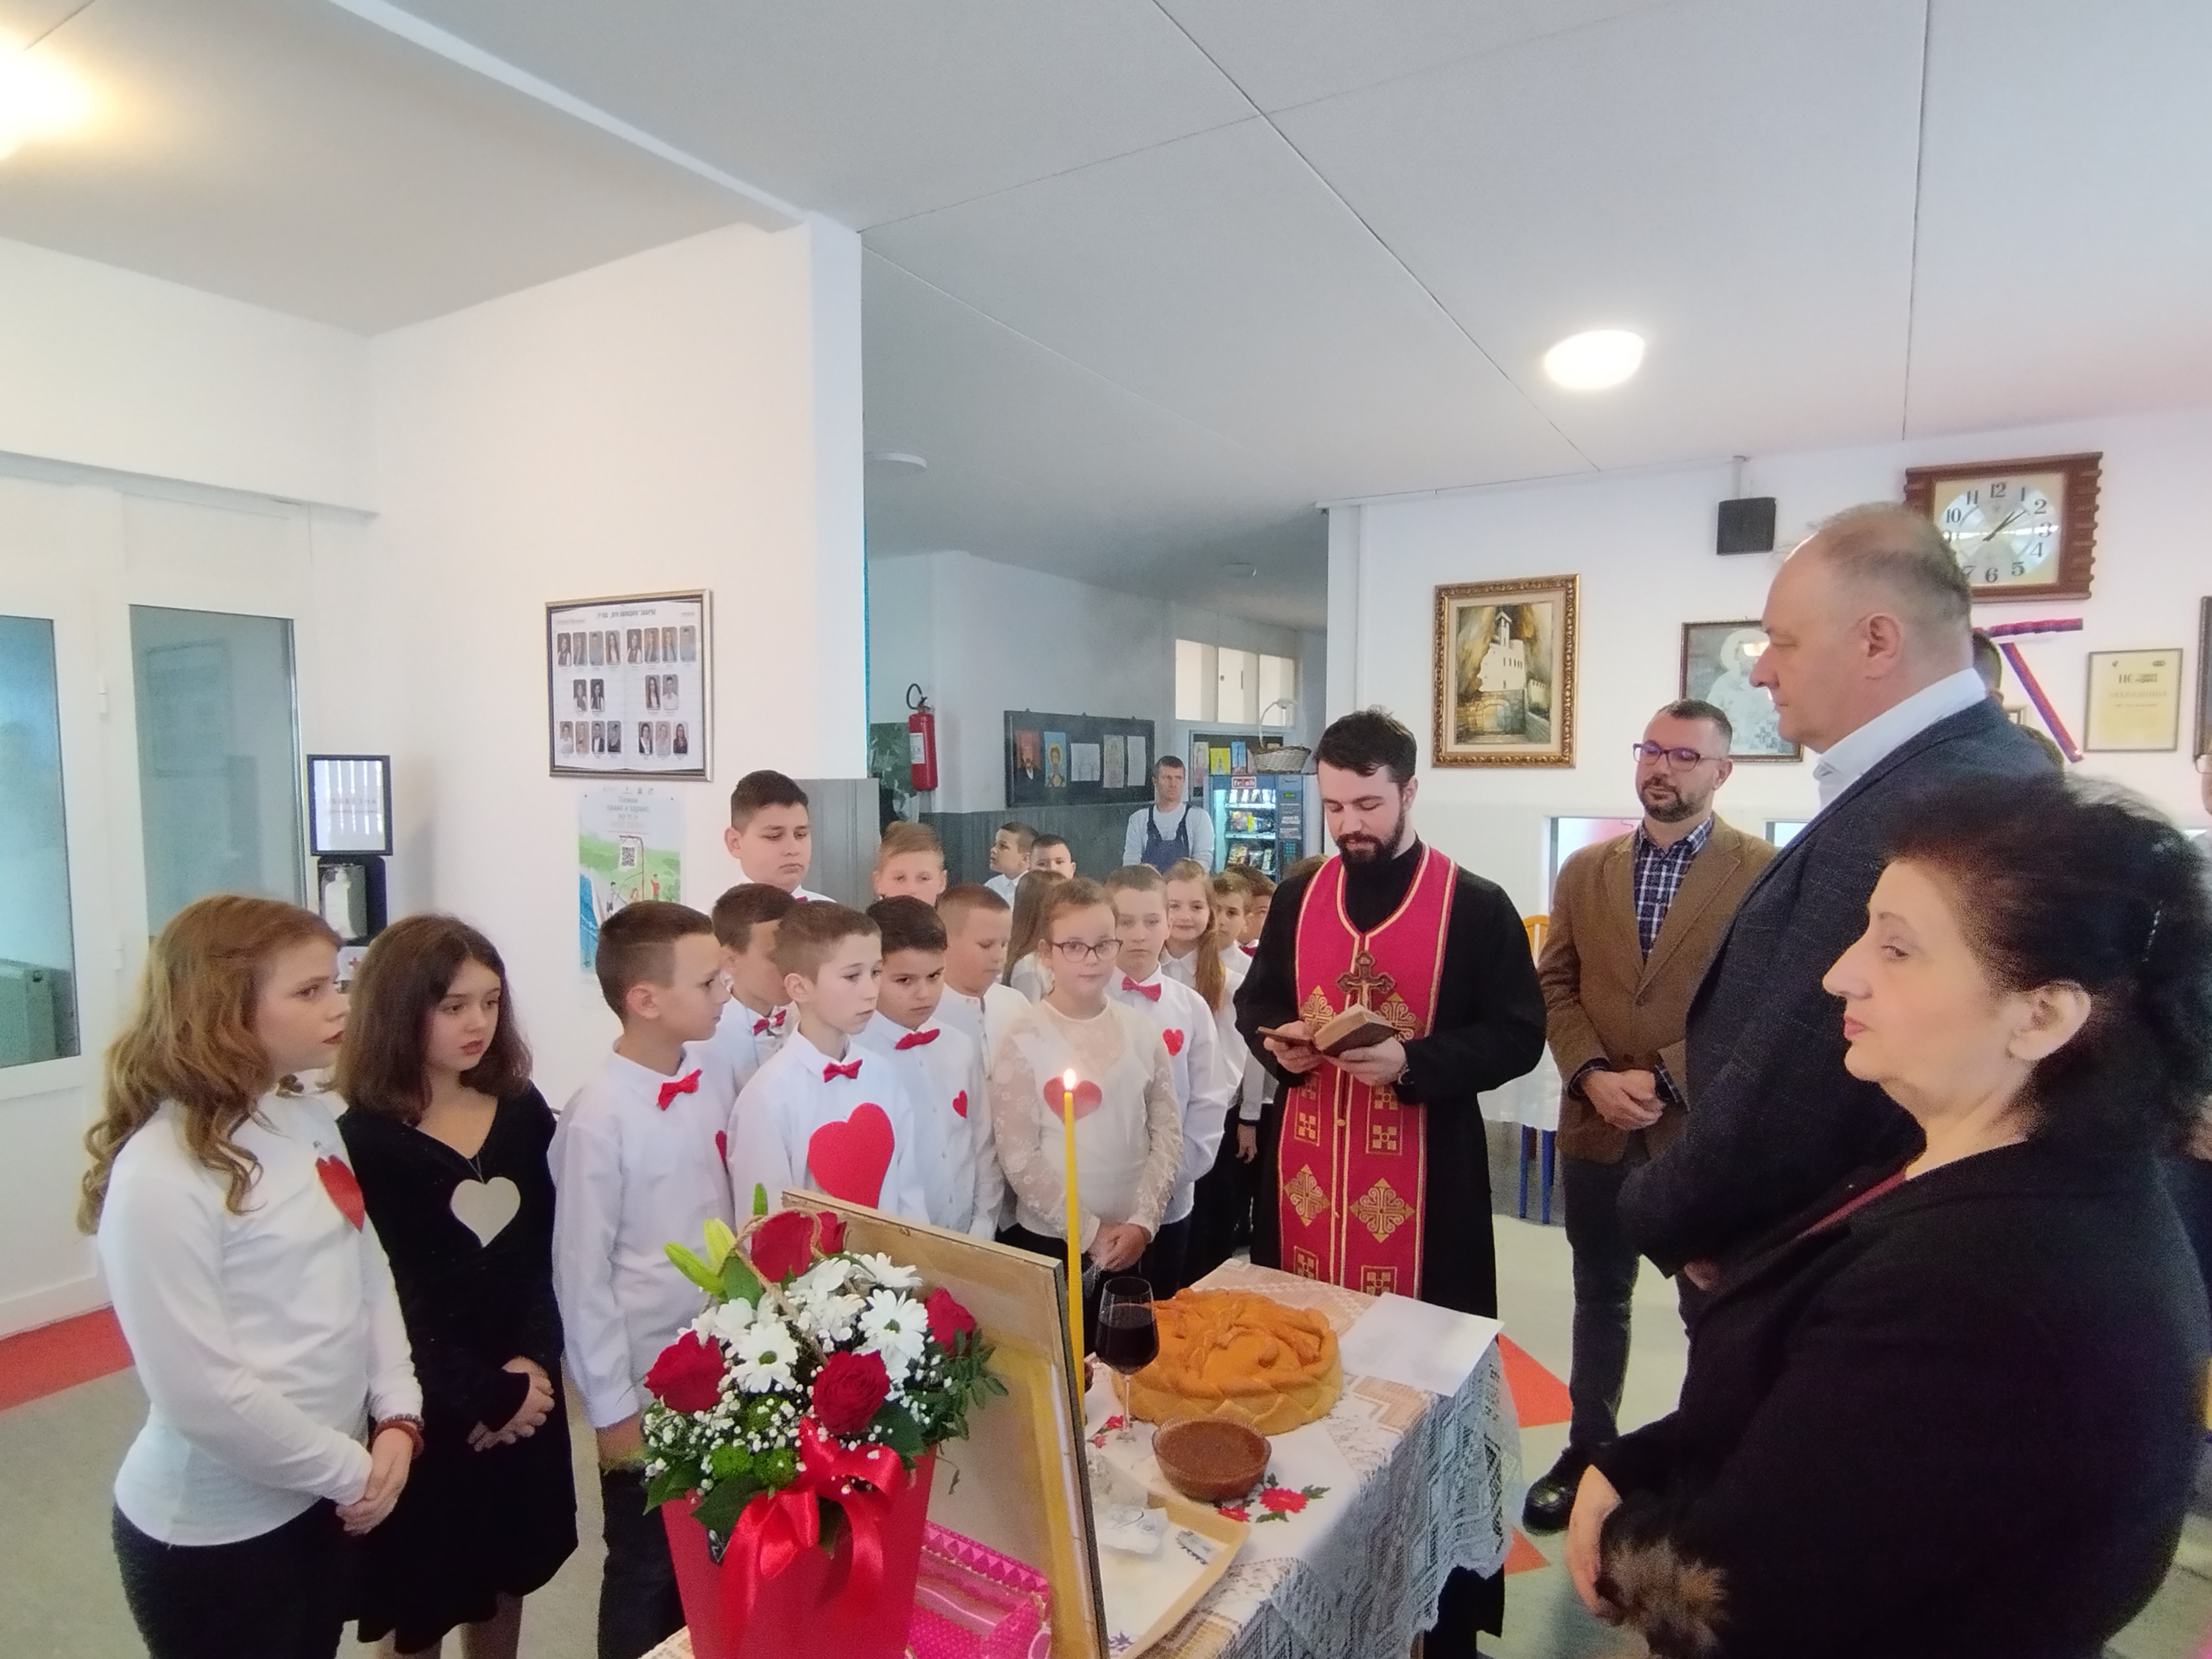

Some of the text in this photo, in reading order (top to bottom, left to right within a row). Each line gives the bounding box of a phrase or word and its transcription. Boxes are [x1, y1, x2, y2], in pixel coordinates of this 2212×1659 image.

[1966, 490, 1979, 505] 11
[1990, 482, 2007, 498] 12
[2020, 487, 2026, 501] 1
[2034, 499, 2047, 514] 2
[1946, 508, 1962, 523] 10
[2039, 522, 2052, 538] 3
[2030, 542, 2043, 557] 4
[1985, 567, 1999, 583] 6
[2011, 561, 2025, 577] 5
